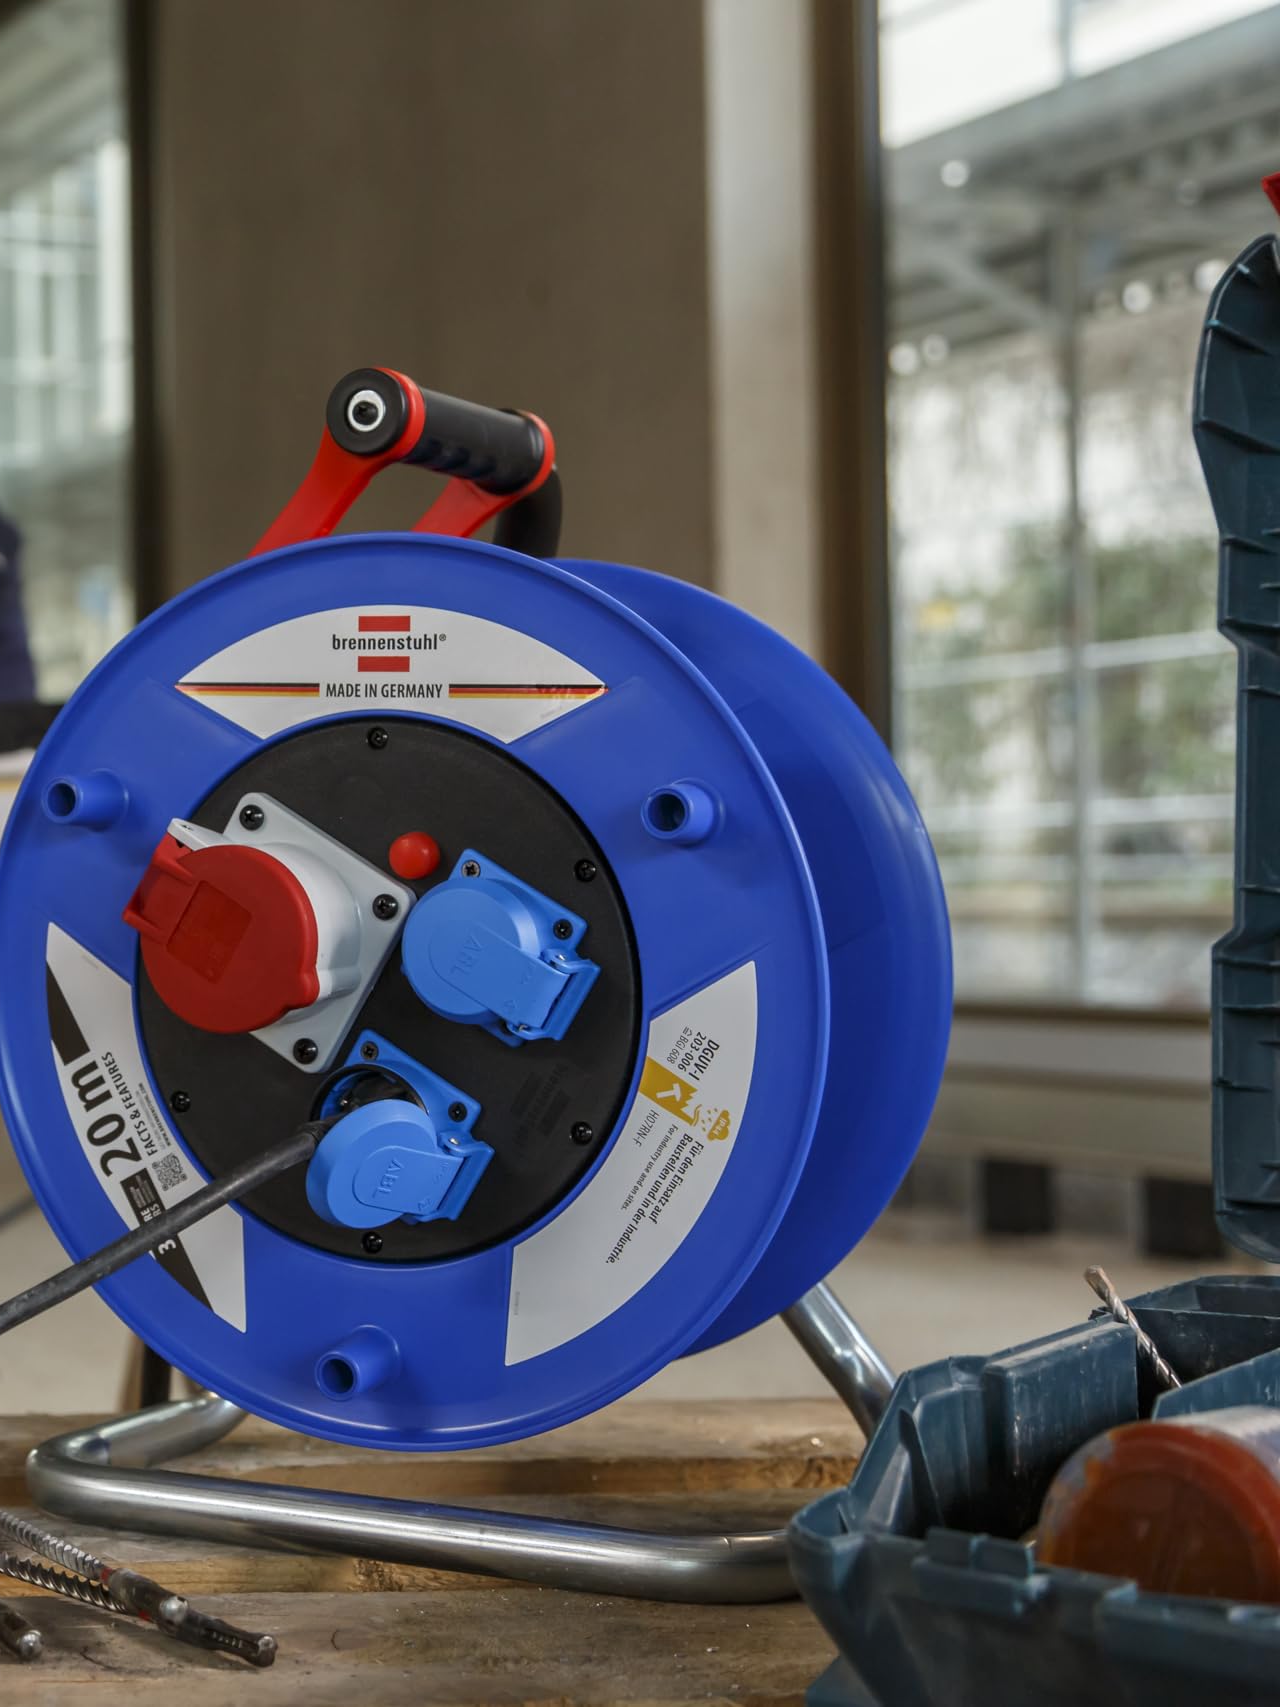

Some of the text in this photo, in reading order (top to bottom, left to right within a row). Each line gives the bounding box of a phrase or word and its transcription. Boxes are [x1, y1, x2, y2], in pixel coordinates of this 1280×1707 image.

[326, 684, 443, 698] MADE IN GERMANY
[667, 1049, 680, 1064] 608
[678, 1032, 706, 1072] 203-006
[102, 1052, 135, 1109] FEATURES
[72, 1060, 142, 1176] 20 m
[130, 1109, 140, 1120] &
[134, 1120, 158, 1156] FACTS
[633, 1110, 659, 1147] H07RN-F
[668, 1124, 678, 1135] For
[650, 1135, 671, 1162] industry
[373, 1159, 404, 1199] ABL
[636, 1173, 646, 1187] and
[644, 1162, 654, 1173] use
[631, 1186, 639, 1194] on
[649, 1141, 704, 1224] Für den Einsatz auf
[606, 1134, 693, 1263] Baustellen und in der Industrie.
[158, 1240, 176, 1254] 3
